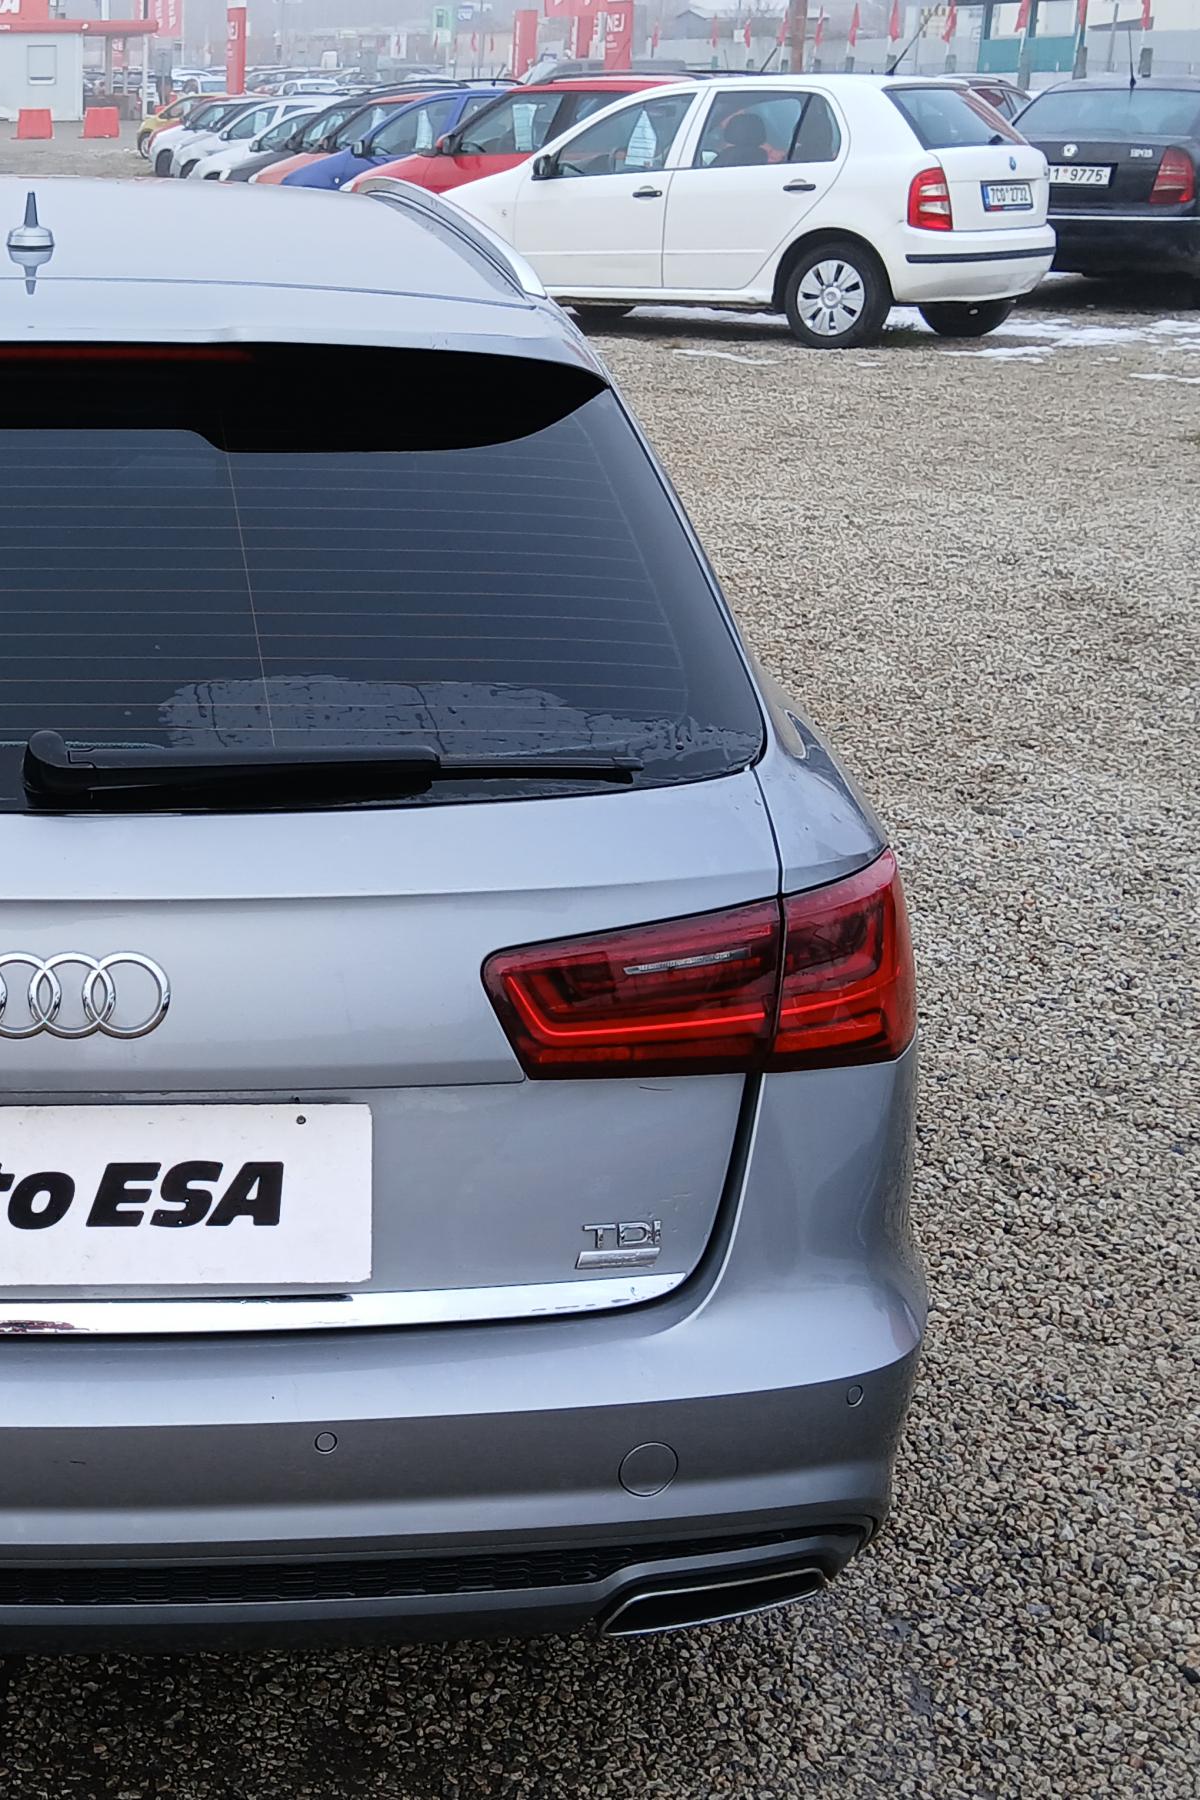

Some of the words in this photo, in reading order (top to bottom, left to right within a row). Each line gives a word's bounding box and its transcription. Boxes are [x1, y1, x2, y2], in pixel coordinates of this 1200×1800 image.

[1070, 168, 1104, 182] 9775
[85, 1160, 284, 1228] ESA
[583, 1220, 661, 1248] TDI
